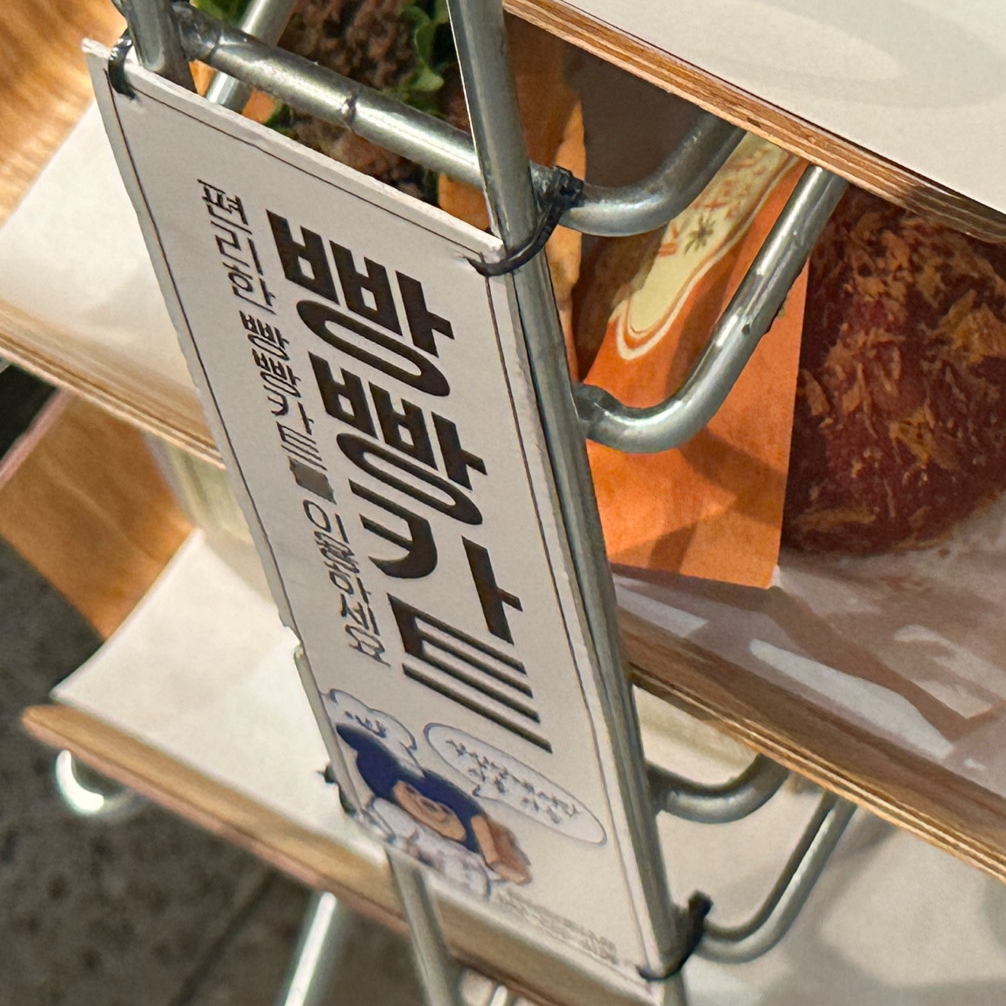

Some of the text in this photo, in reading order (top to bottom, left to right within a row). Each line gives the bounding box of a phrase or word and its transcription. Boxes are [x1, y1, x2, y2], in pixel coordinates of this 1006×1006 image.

[197, 179, 277, 315] 편리한
[239, 310, 337, 505] 빵빵카트
[303, 499, 391, 667] 이용하세요
[265, 209, 553, 754] 빵빵카트
